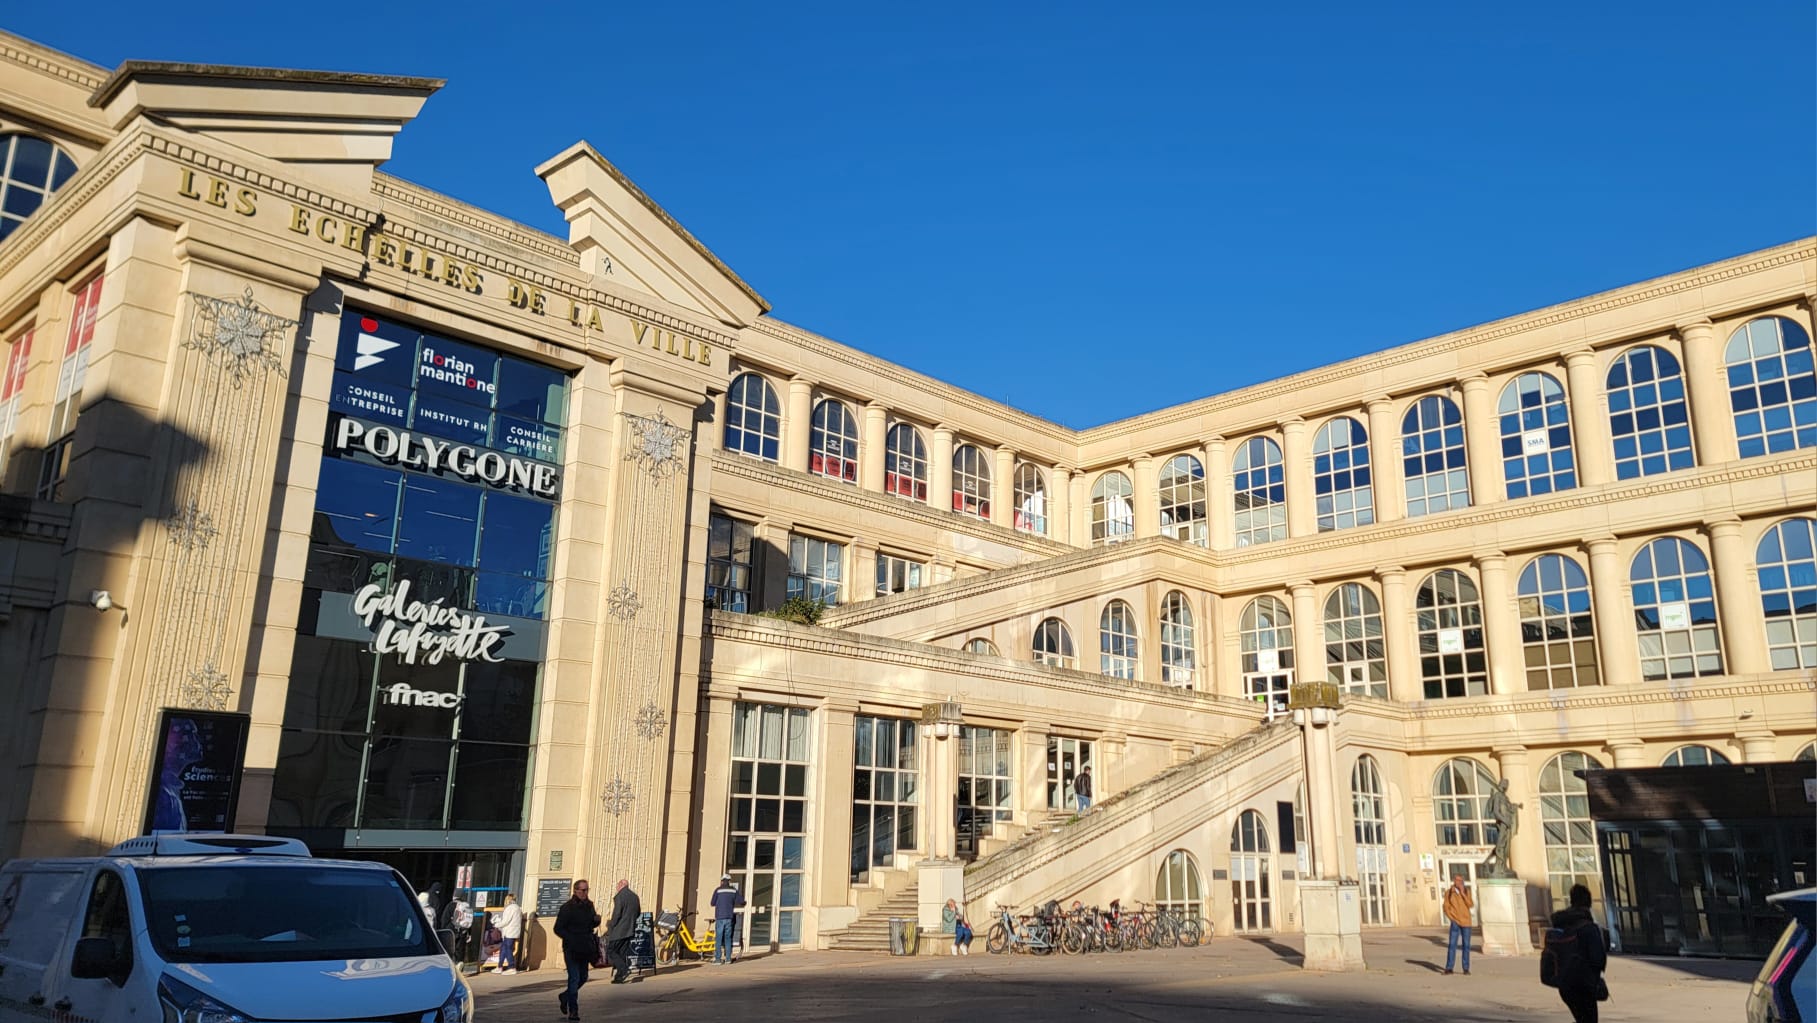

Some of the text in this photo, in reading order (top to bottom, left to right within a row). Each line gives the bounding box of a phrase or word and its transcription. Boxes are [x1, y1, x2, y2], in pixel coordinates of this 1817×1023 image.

[178, 167, 713, 366] LES ECHELLES DE LA VILLE
[423, 348, 474, 375] florian
[420, 365, 496, 394] mantione
[349, 385, 395, 404] CONSEIL
[420, 408, 488, 432] INSTITUT RH
[510, 426, 550, 443] CONSEIL
[1527, 437, 1545, 447] SMA
[336, 418, 556, 495] POLYGONE
[354, 579, 462, 628] Galeries
[375, 614, 510, 665] Lafayette
[390, 682, 460, 709] fnac
